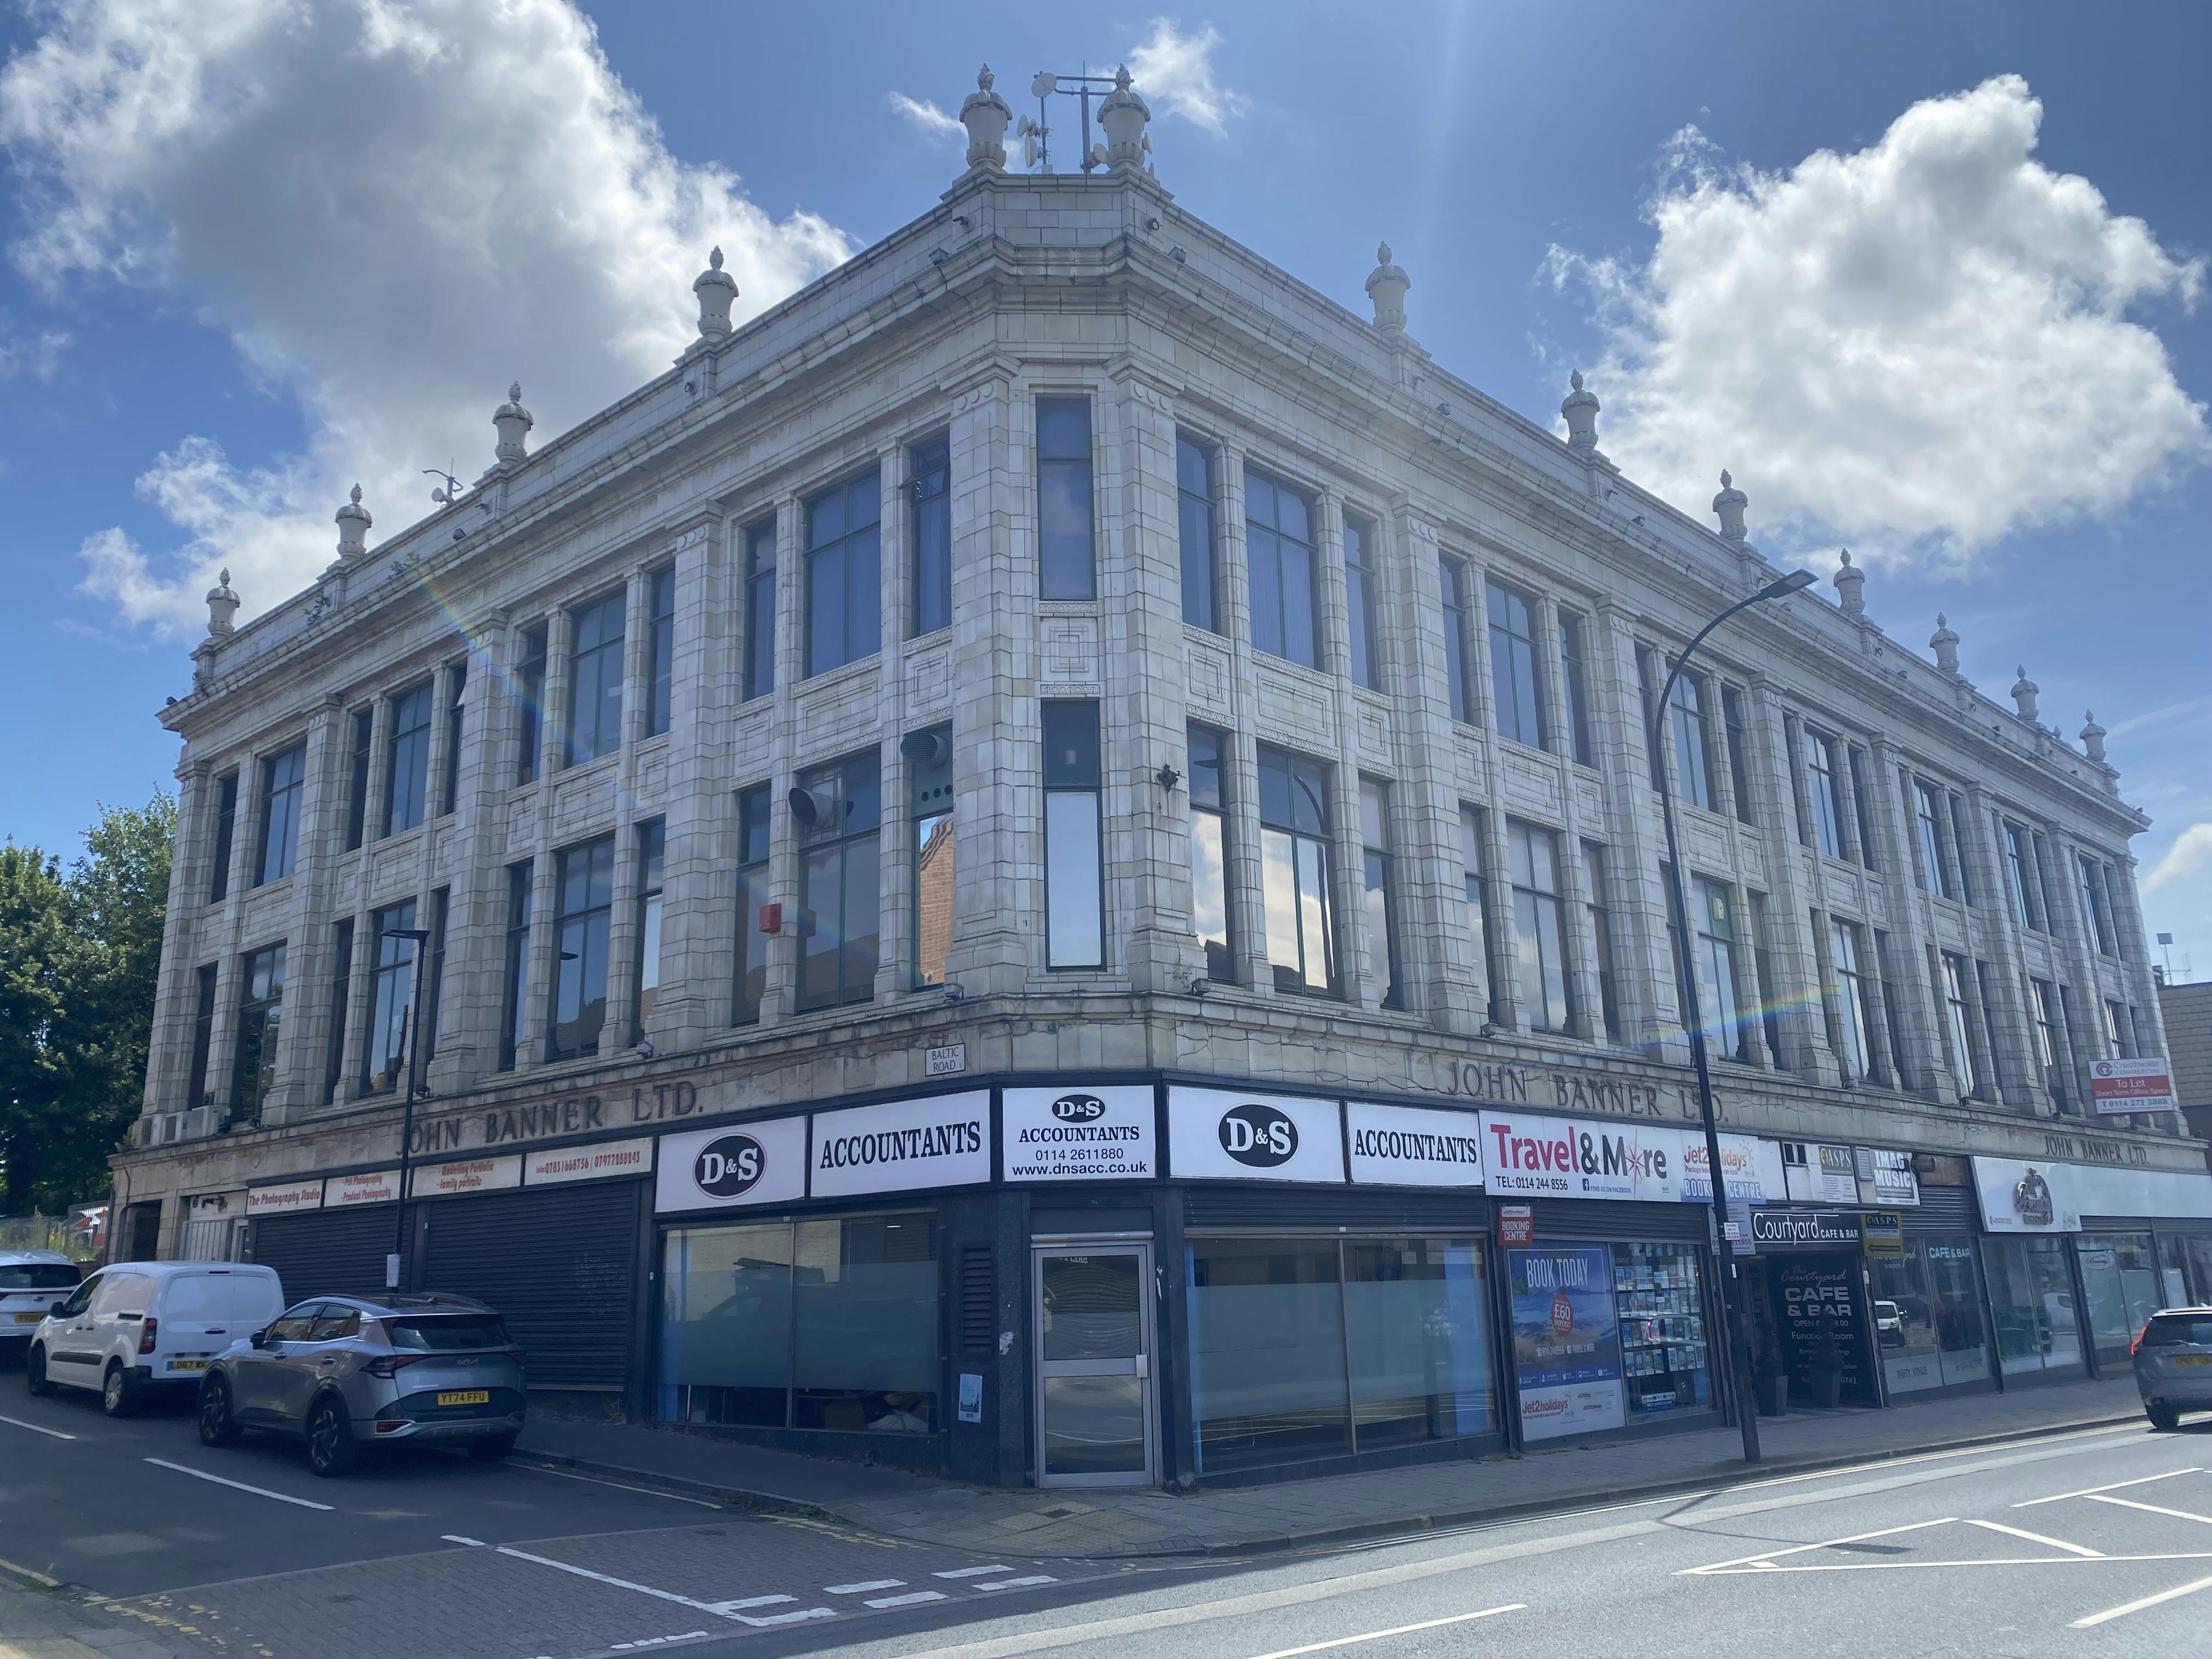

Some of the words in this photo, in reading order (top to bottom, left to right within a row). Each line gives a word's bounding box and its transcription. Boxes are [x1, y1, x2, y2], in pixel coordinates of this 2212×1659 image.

[932, 1047, 959, 1060] BALTIC
[934, 1060, 956, 1073] ROAD
[2114, 1060, 2159, 1069] Crosthwaite
[1448, 1062, 1527, 1102] JOHN
[1553, 1074, 1662, 1116] BANNER
[2115, 1080, 2128, 1088] To
[2131, 1079, 2146, 1088] Let
[485, 1096, 603, 1143] BANNER
[633, 1081, 703, 1122] LTD.
[1057, 1101, 1101, 1117] D&S
[1019, 1126, 1140, 1142] ACCOUNTANTS
[1226, 1118, 1291, 1155] D&S
[820, 1121, 981, 1169] ACCOUNTANTS
[1355, 1129, 1477, 1164] ACCOUNTANTS
[2045, 1135, 2074, 1157] JOHN
[2080, 1139, 2124, 1163] BANNER
[2127, 1144, 2150, 1165] LTD.
[1035, 1149, 1066, 1160] 0114
[1070, 1148, 1124, 1160] 2611880
[1684, 1146, 1747, 1171] Jet2lidays
[701, 1148, 758, 1185] D&S
[1012, 1161, 1147, 1175] www.dnsacc.co.uk
[458, 1176, 482, 1189] portraits
[1496, 1176, 1515, 1188] TEL:
[1516, 1177, 1534, 1189] 0114
[1536, 1177, 1550, 1190] 244
[1551, 1178, 1568, 1190] 8556
[1874, 1169, 1911, 1188] MUSIC
[249, 1195, 259, 1206] The
[261, 1191, 300, 1206] Photography
[301, 1188, 320, 1200] Studio
[362, 1187, 391, 1200] Photography
[1684, 1179, 1713, 1198] BOOKI
[1728, 1181, 1762, 1200] CENTRE
[1502, 1221, 1530, 1231] BOOKING
[1754, 1214, 1819, 1245] Courtyard
[1821, 1229, 1838, 1238] CAFE
[1839, 1229, 1844, 1238] &
[1846, 1229, 1859, 1238] BAR
[1504, 1231, 1527, 1241] CENTRE
[1929, 1247, 1949, 1259] CAFE
[1951, 1249, 1956, 1257] &
[1957, 1248, 1971, 1258] BAR
[1526, 1259, 1555, 1288] BOOK
[1556, 1259, 1588, 1287] TODAY
[1782, 1269, 1847, 1288] Courtyard
[1785, 1287, 1850, 1301] CAFE
[1554, 1304, 1571, 1320] £60
[1788, 1305, 1802, 1317] &
[1808, 1304, 1852, 1316] BAR
[1554, 1319, 1571, 1328] DEPOSIT
[1792, 1331, 1821, 1340] Functio
[1829, 1331, 1854, 1340] Room
[442, 1393, 465, 1403] YT74
[467, 1393, 484, 1402] FFU
[1522, 1398, 1568, 1414] Jet2holidays
